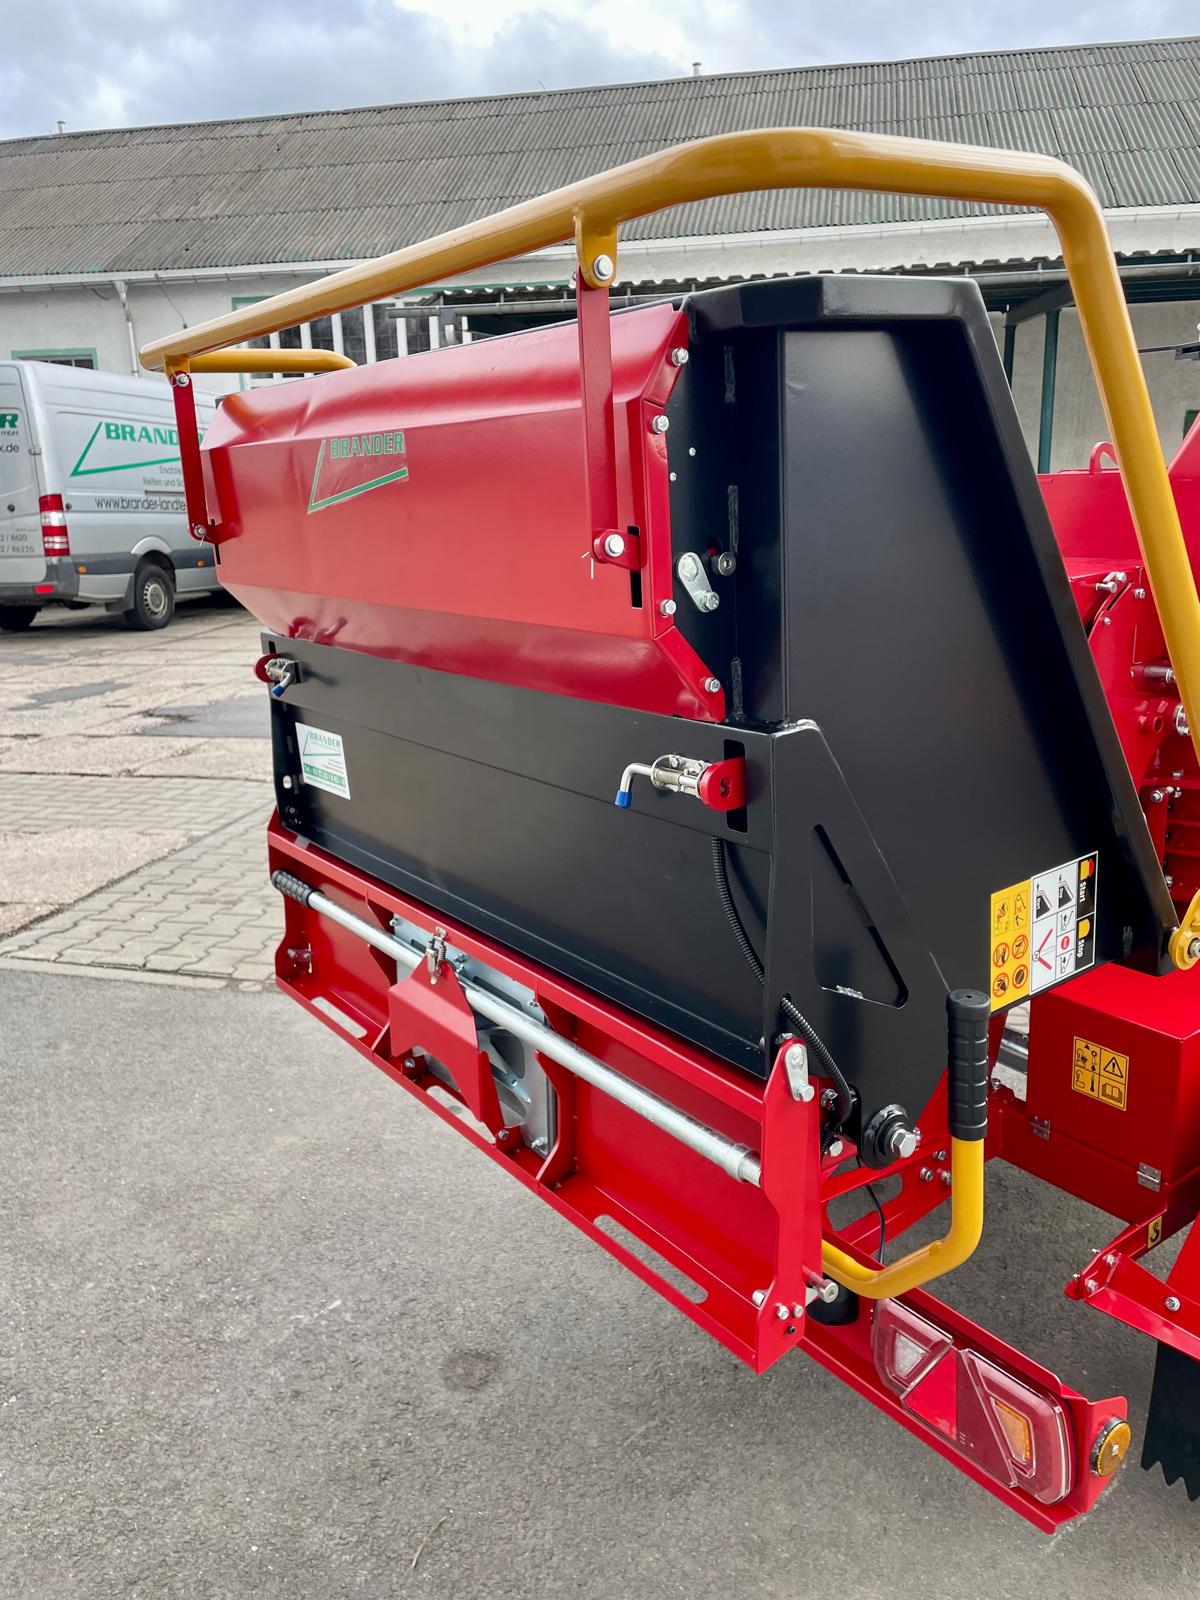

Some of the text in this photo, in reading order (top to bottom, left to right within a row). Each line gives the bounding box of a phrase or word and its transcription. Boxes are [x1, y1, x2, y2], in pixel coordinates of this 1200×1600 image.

[105, 422, 203, 446] BRAND
[330, 432, 405, 458] BRANDER
[309, 730, 341, 749] BRANDER
[1077, 939, 1085, 957] Stop
